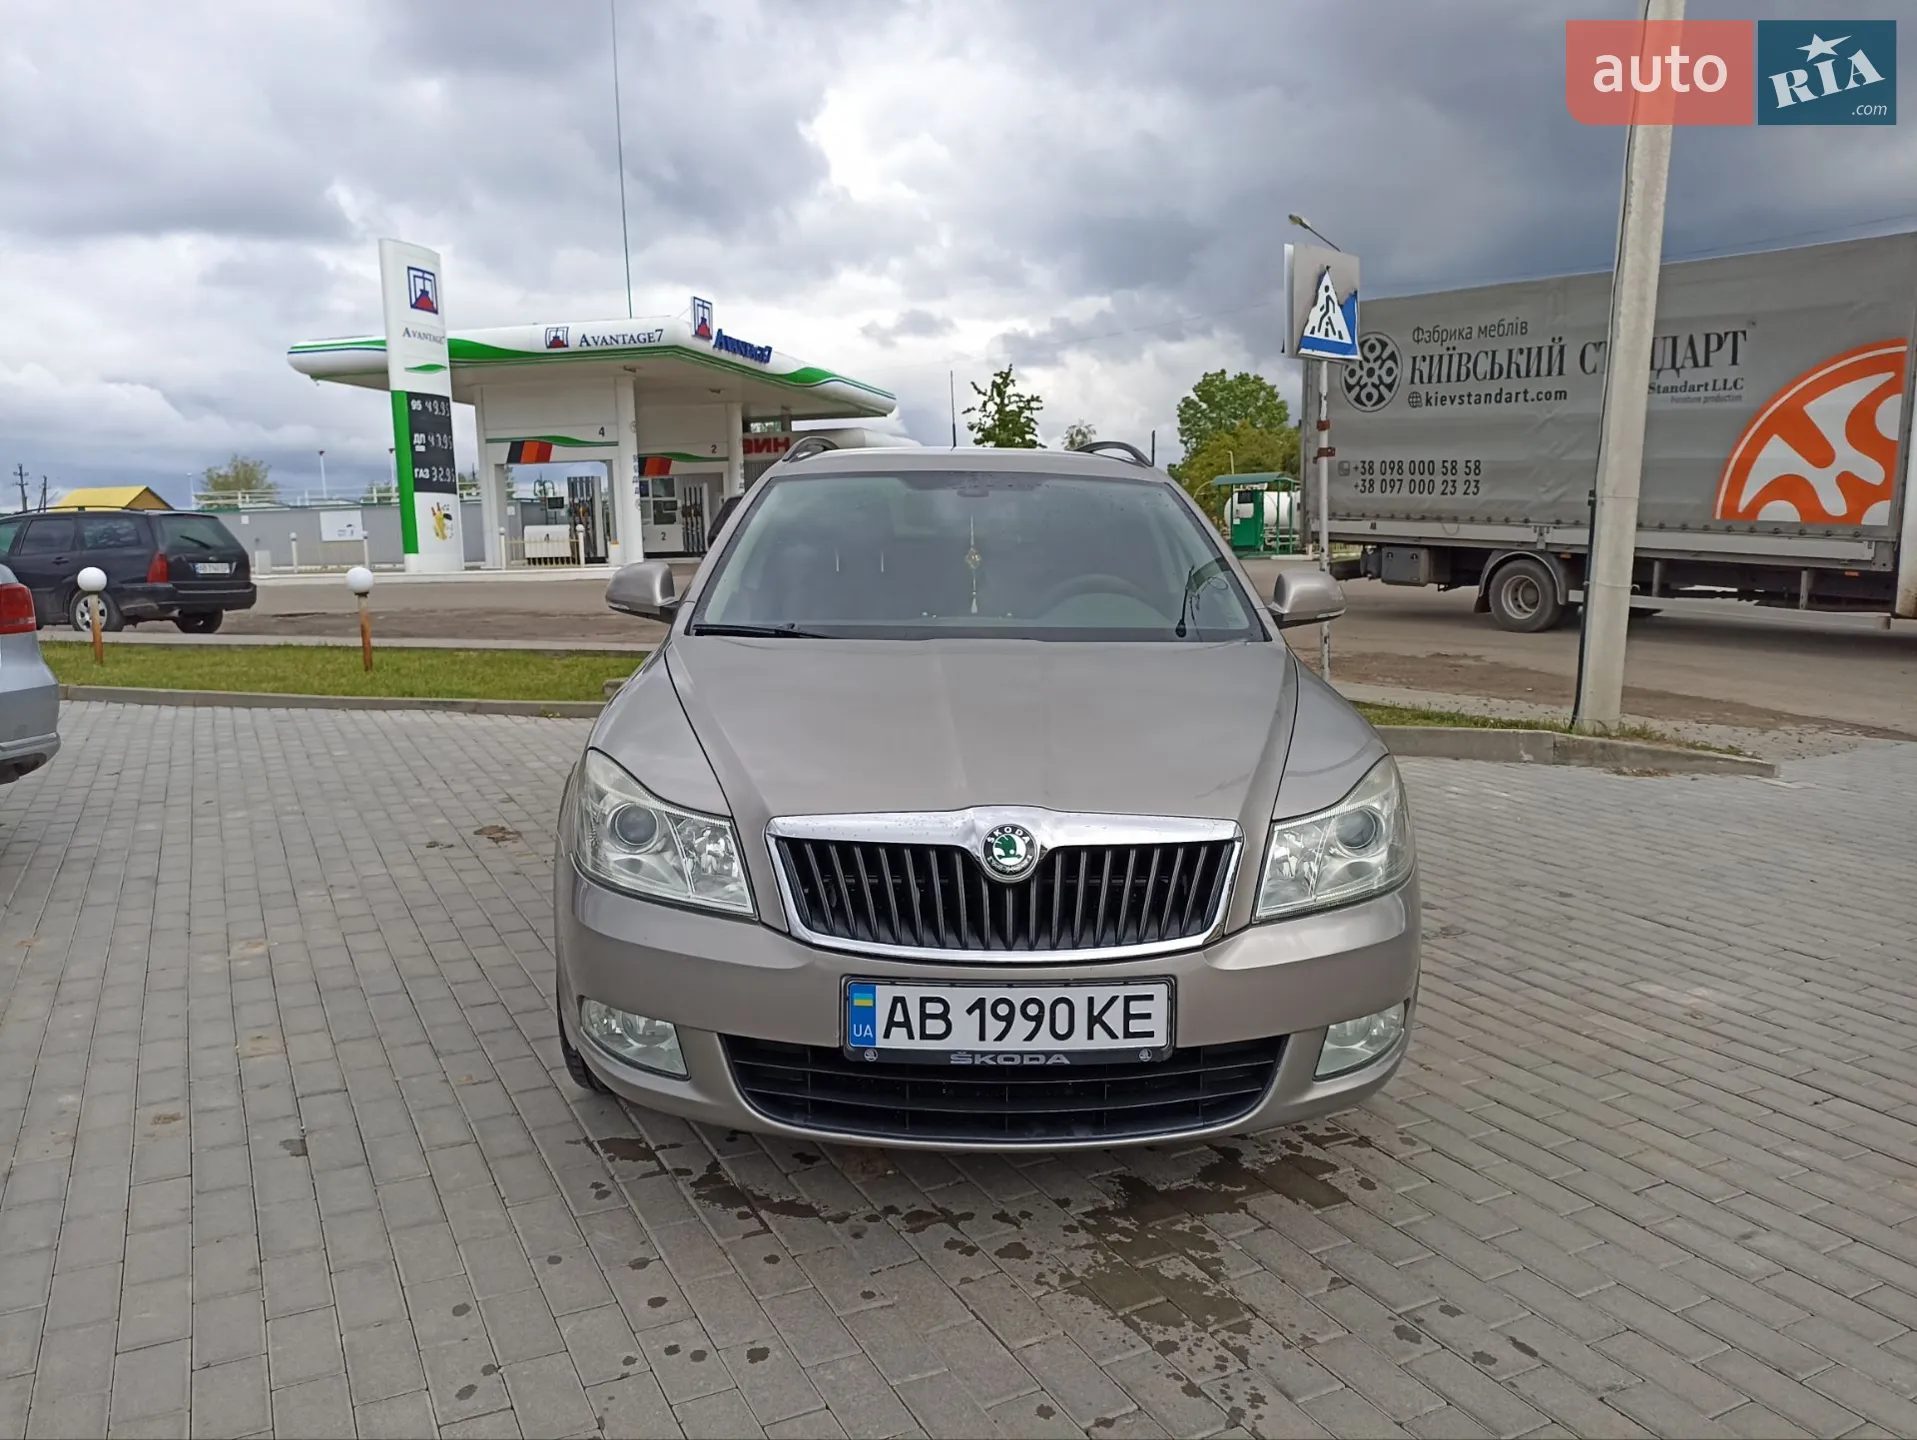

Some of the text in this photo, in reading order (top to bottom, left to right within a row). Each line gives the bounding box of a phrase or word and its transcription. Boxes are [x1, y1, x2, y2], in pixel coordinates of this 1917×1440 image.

[1412, 317, 1528, 347] Фабрика меблів
[1408, 336, 1567, 386] КИЇВСЬКИЙ
[1648, 377, 1744, 394] Standart LLC
[411, 399, 422, 411] 95
[1425, 388, 1568, 407] kievstandart.com
[598, 426, 605, 437] 4
[711, 444, 717, 454] 2
[414, 467, 430, 479] ГАЗ
[1354, 460, 1481, 476] +38 098 000 58 58
[1354, 479, 1481, 495] +38 097 000 23 23
[661, 532, 667, 541] 2
[883, 994, 1155, 1042] AB 1990 KE
[853, 1024, 873, 1038] UA
[950, 1052, 1071, 1066] ŠKODA
